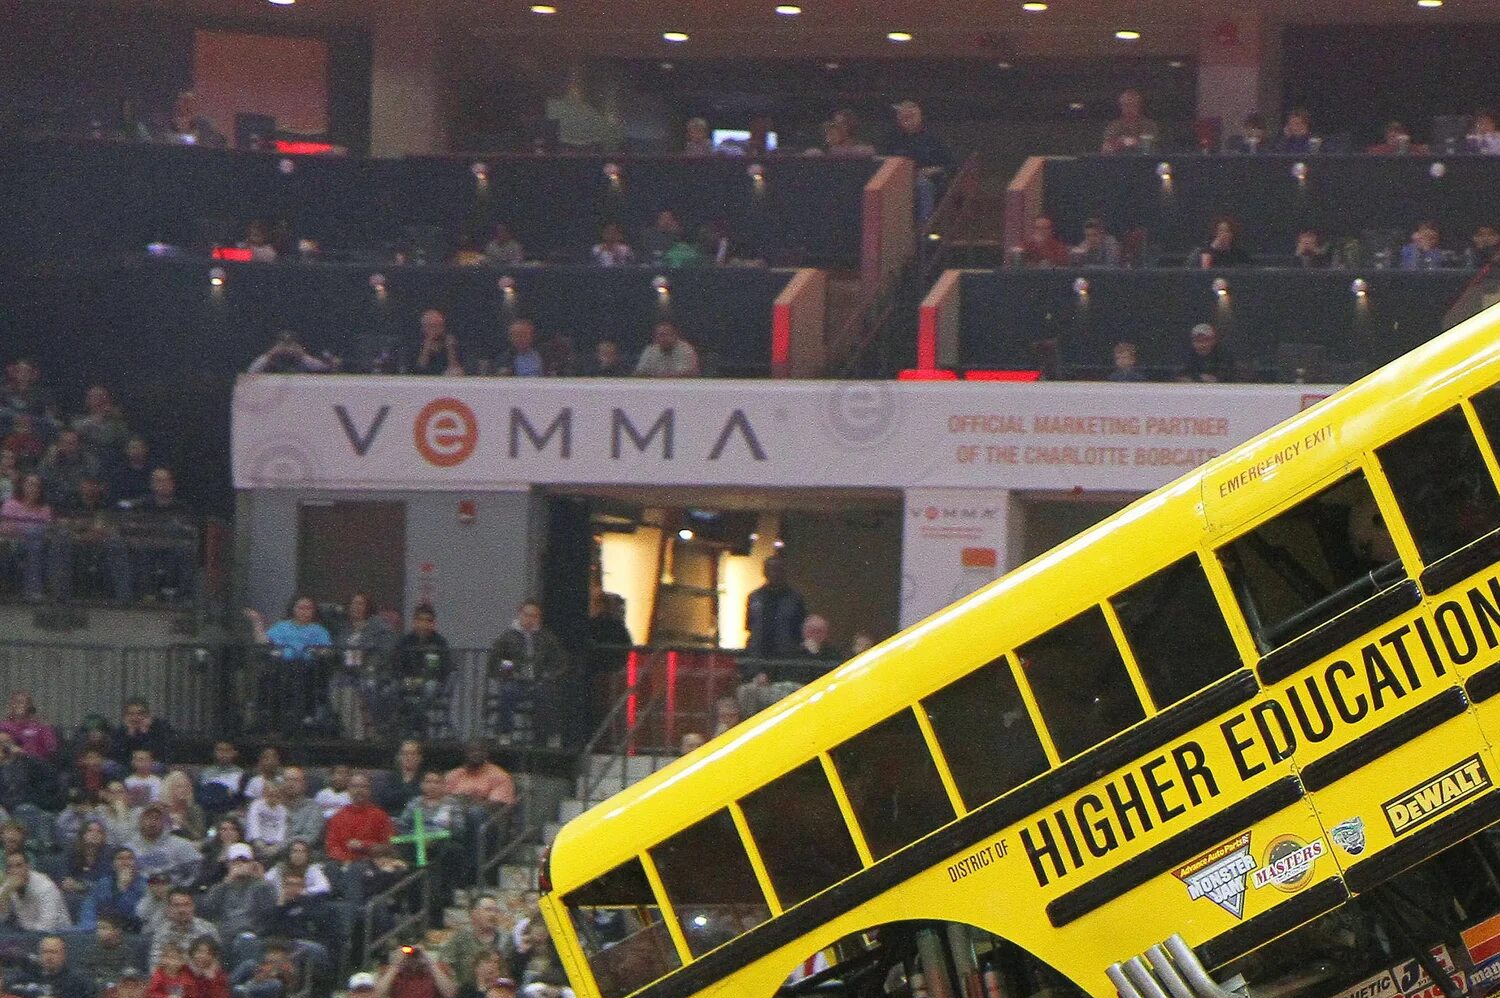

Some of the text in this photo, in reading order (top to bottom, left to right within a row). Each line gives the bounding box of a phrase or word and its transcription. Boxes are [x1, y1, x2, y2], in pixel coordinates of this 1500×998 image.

[949, 415, 1228, 436] OFFICIAL MARKETING PARTNER
[957, 446, 979, 464] OF
[986, 446, 1017, 464] THE
[1024, 446, 1128, 465] CHARLOTTE
[1219, 424, 1334, 498] EMERGENCY EXIT
[1019, 739, 1221, 888] HIGHER
[947, 838, 1009, 883] DISTRICT OF
[1180, 840, 1243, 878] Advance Auto Parts
[1187, 854, 1257, 901] MONSTER
[1255, 842, 1322, 885] MASTERS
[1206, 877, 1246, 905] JAM
